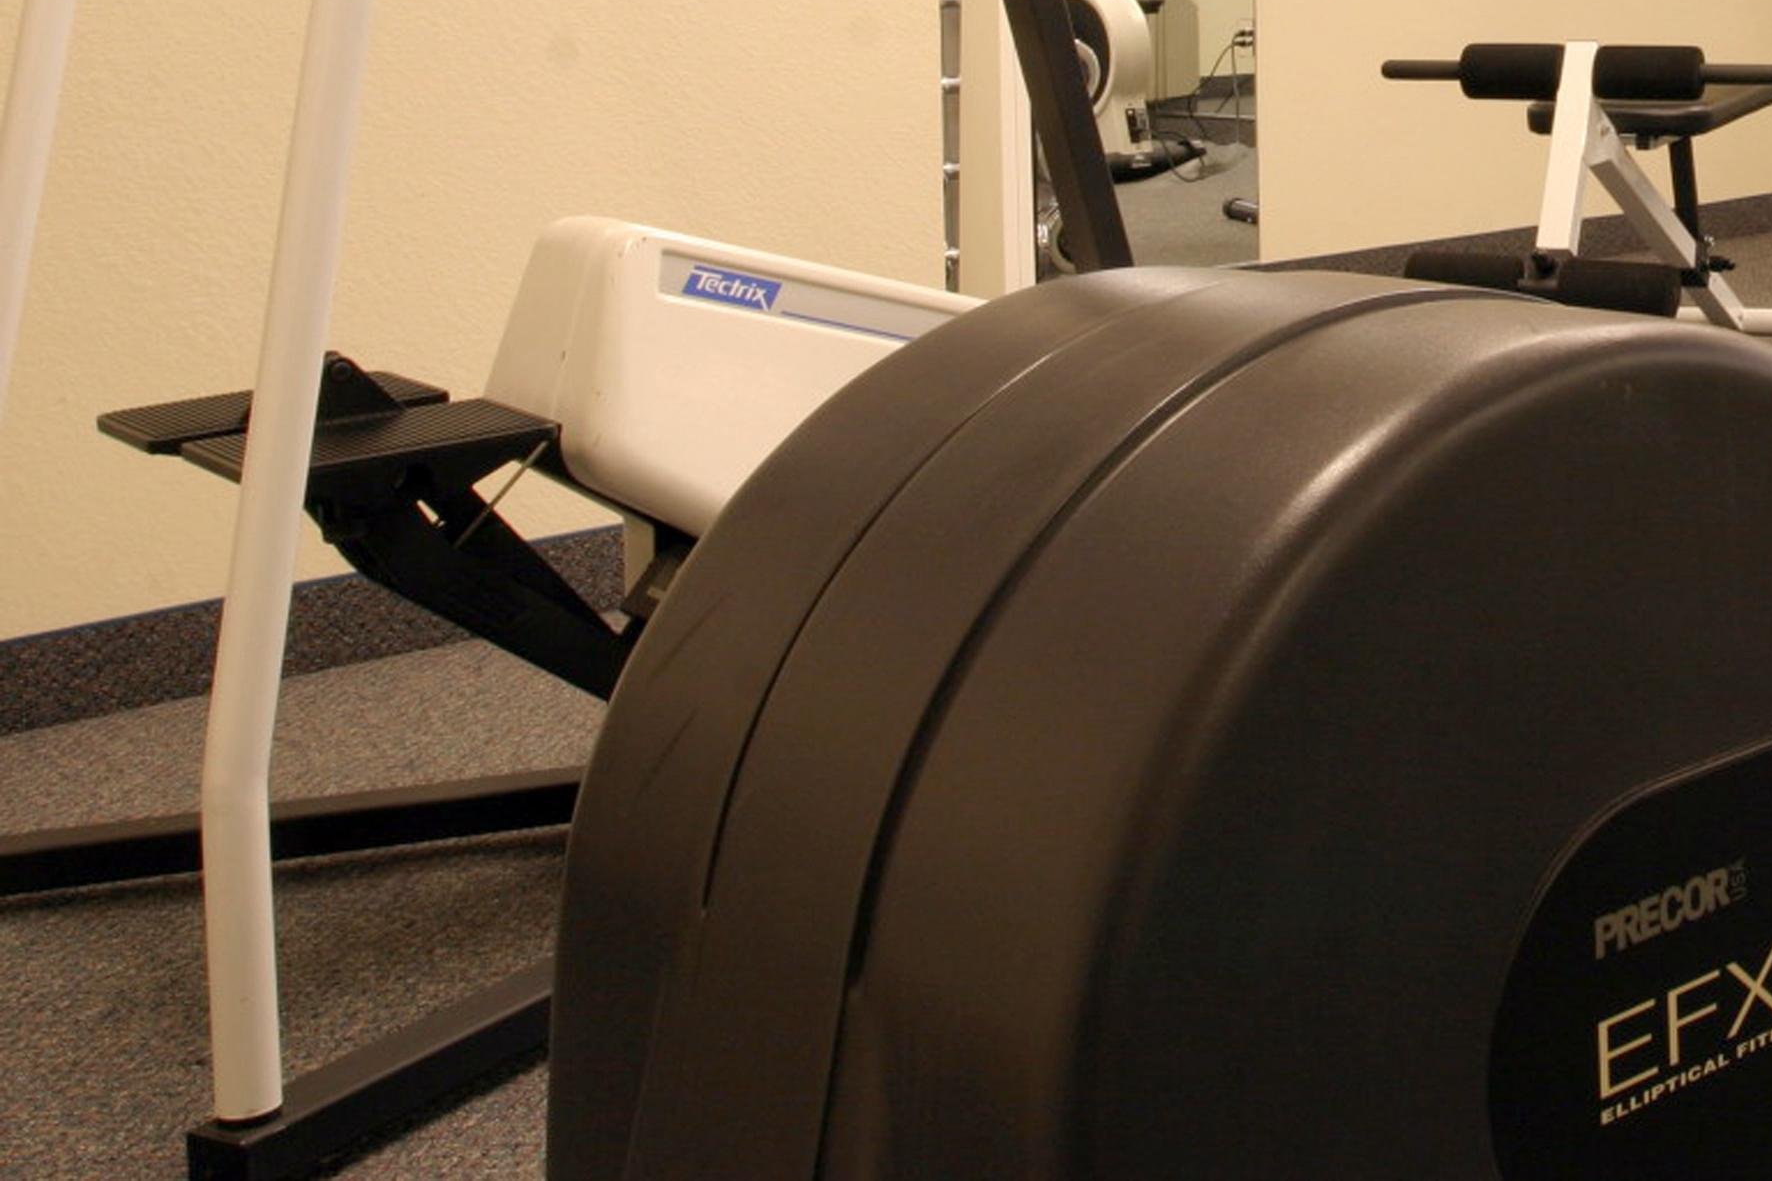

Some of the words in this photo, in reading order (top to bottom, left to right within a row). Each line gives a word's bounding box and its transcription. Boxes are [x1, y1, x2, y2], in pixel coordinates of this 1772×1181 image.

[690, 269, 769, 311] Tectrix
[1595, 867, 1731, 960] PRECOR
[1600, 1053, 1730, 1126] ELLIPTICAL
